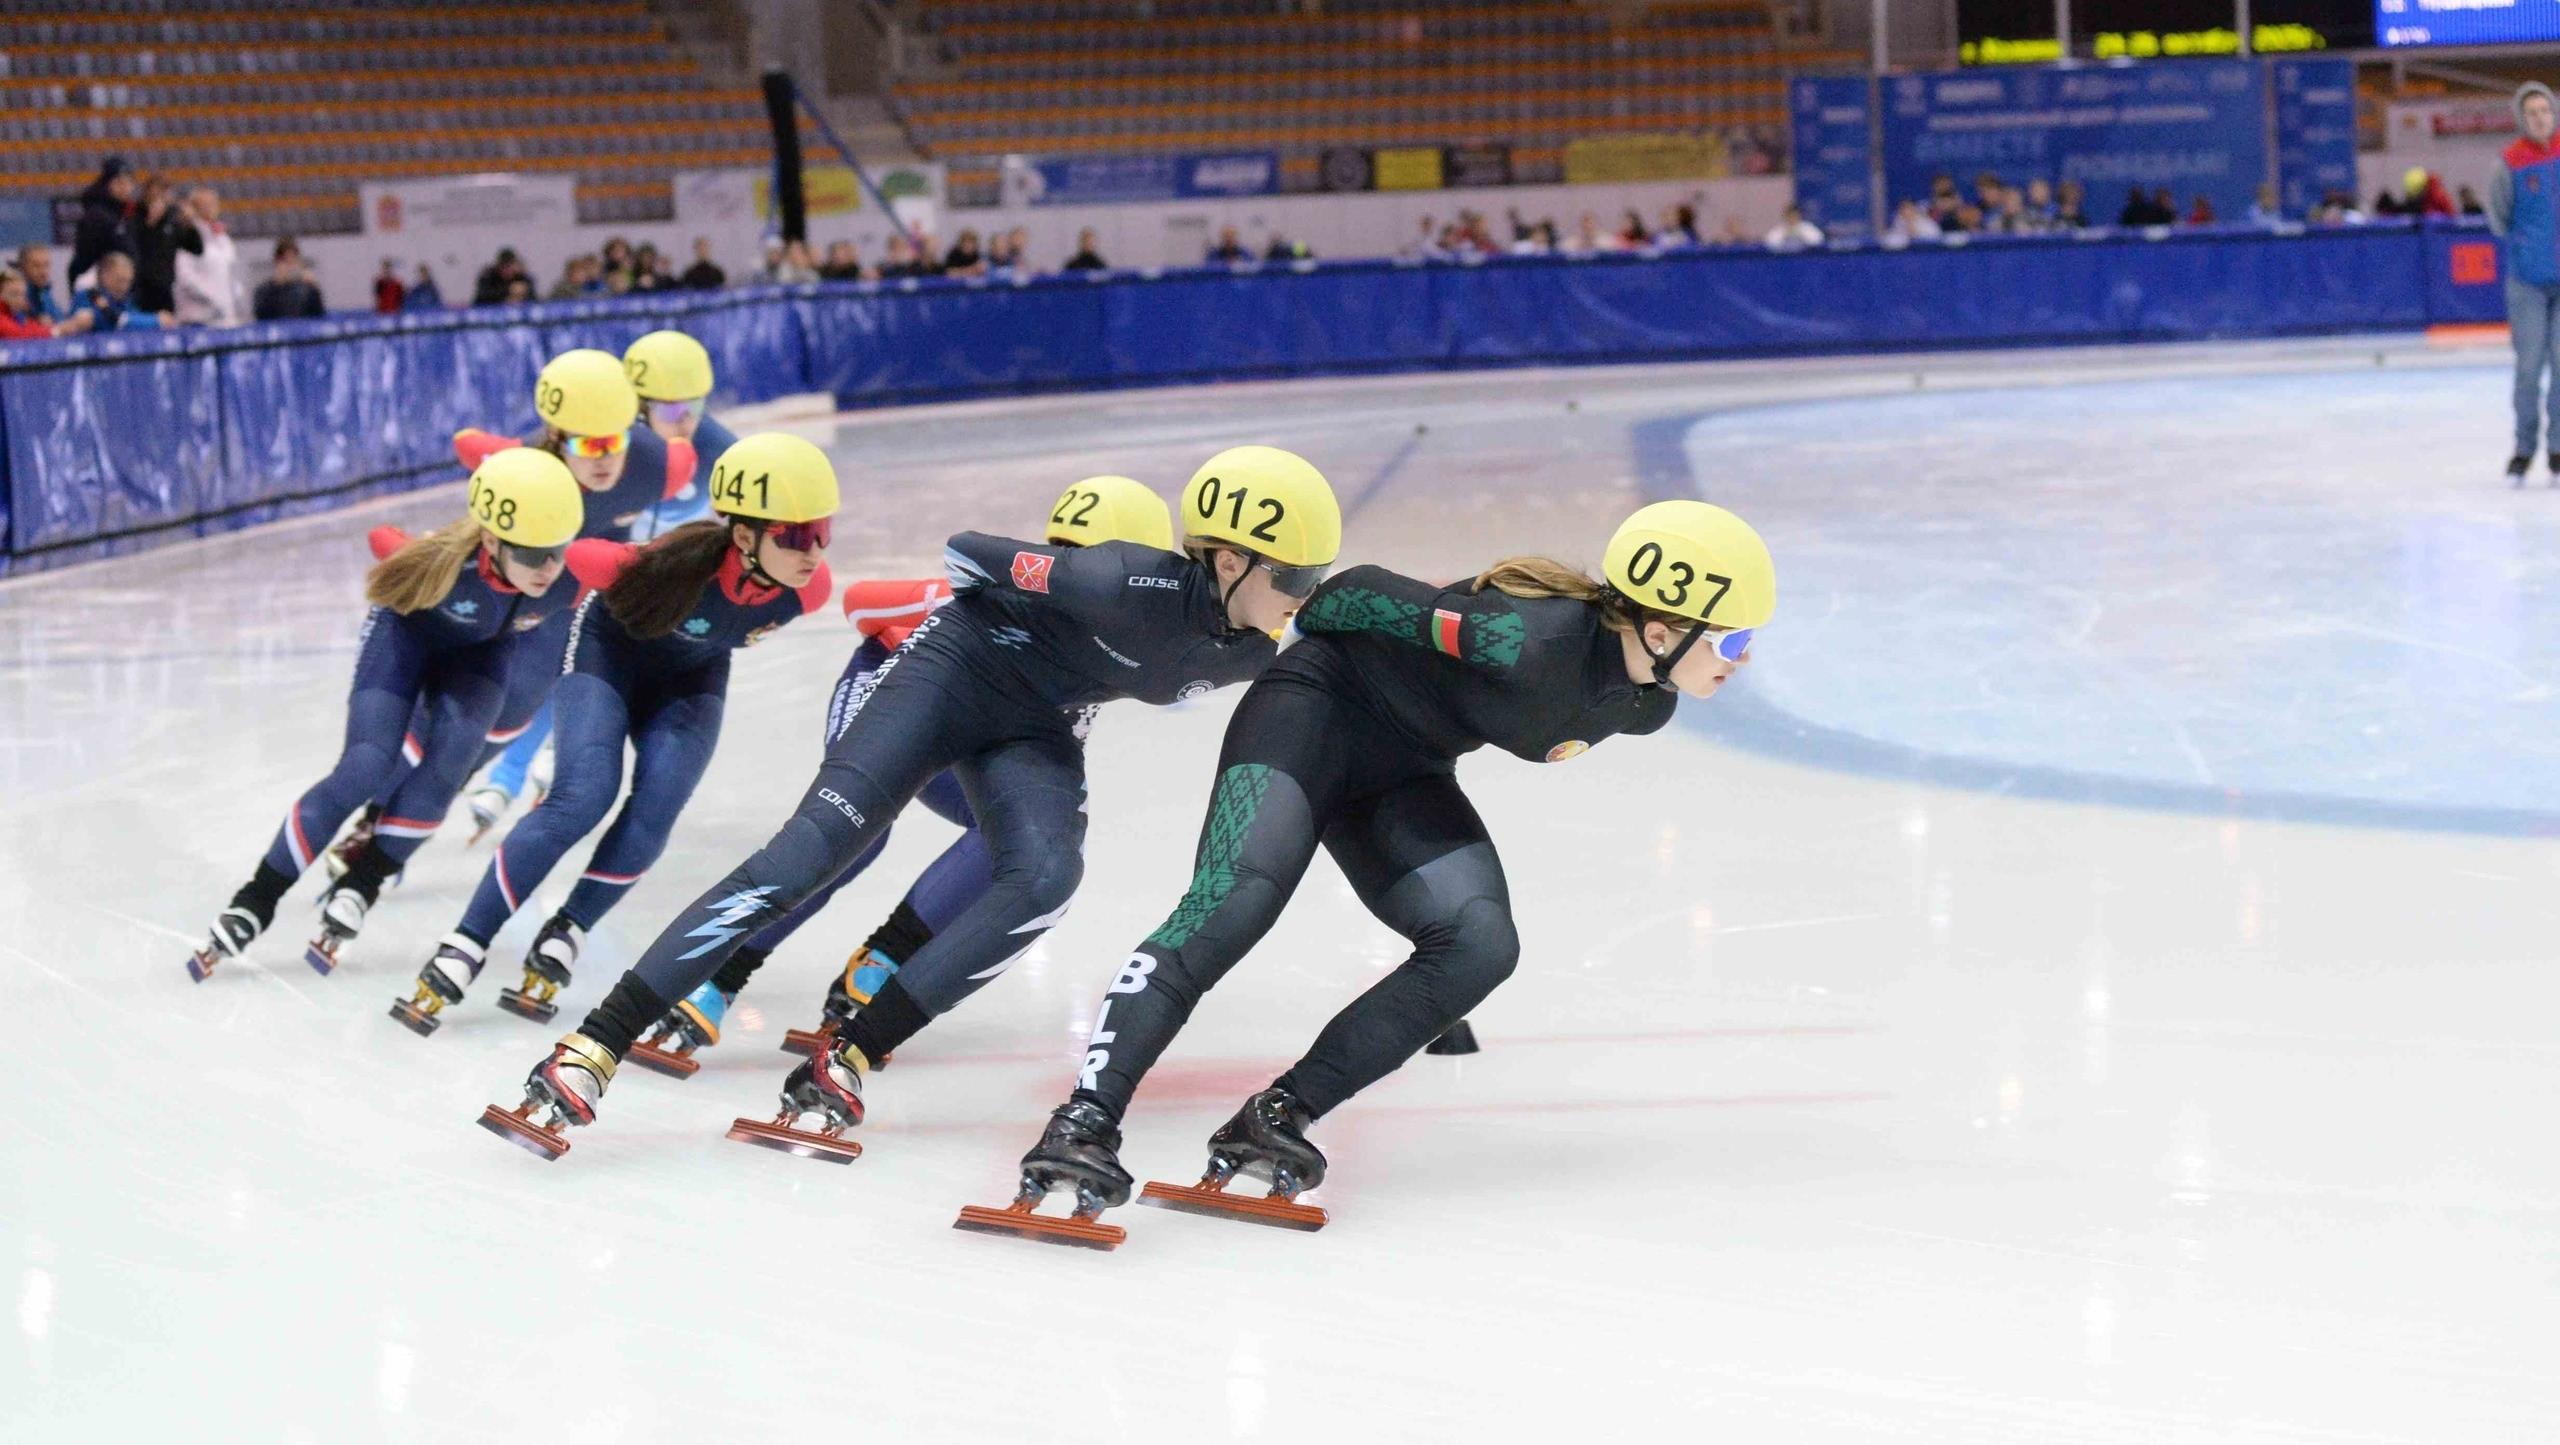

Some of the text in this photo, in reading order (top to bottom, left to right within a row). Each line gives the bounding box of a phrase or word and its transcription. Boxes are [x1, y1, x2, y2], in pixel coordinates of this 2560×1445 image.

[711, 464, 769, 510] 041
[1197, 477, 1285, 543] 012
[1128, 575, 1180, 591] corsa
[1627, 541, 1733, 620] 037
[817, 787, 866, 829] corsa
[1074, 952, 1158, 1091] BLR
